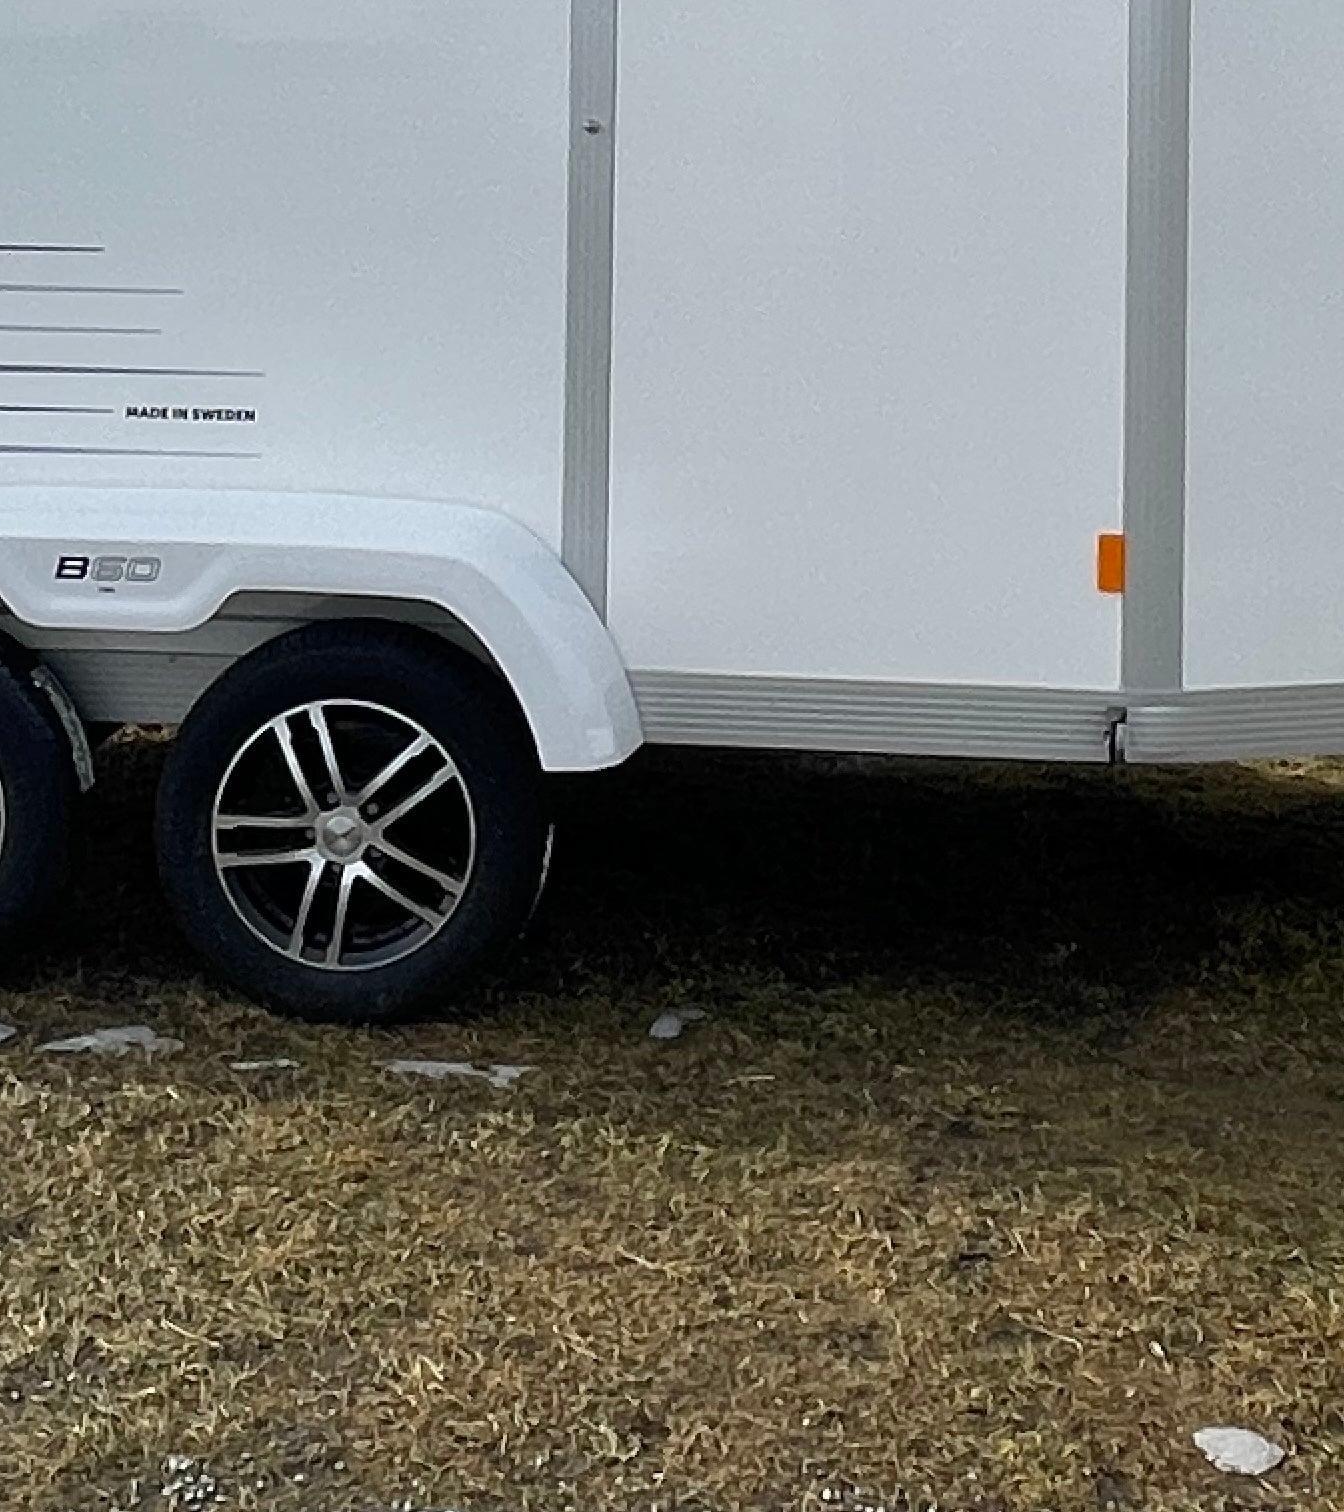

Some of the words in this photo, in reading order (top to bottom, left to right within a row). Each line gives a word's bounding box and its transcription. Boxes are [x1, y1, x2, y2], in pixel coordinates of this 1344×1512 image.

[125, 406, 169, 419] MADE
[173, 407, 188, 420] IN
[192, 408, 256, 422] SWEDEN
